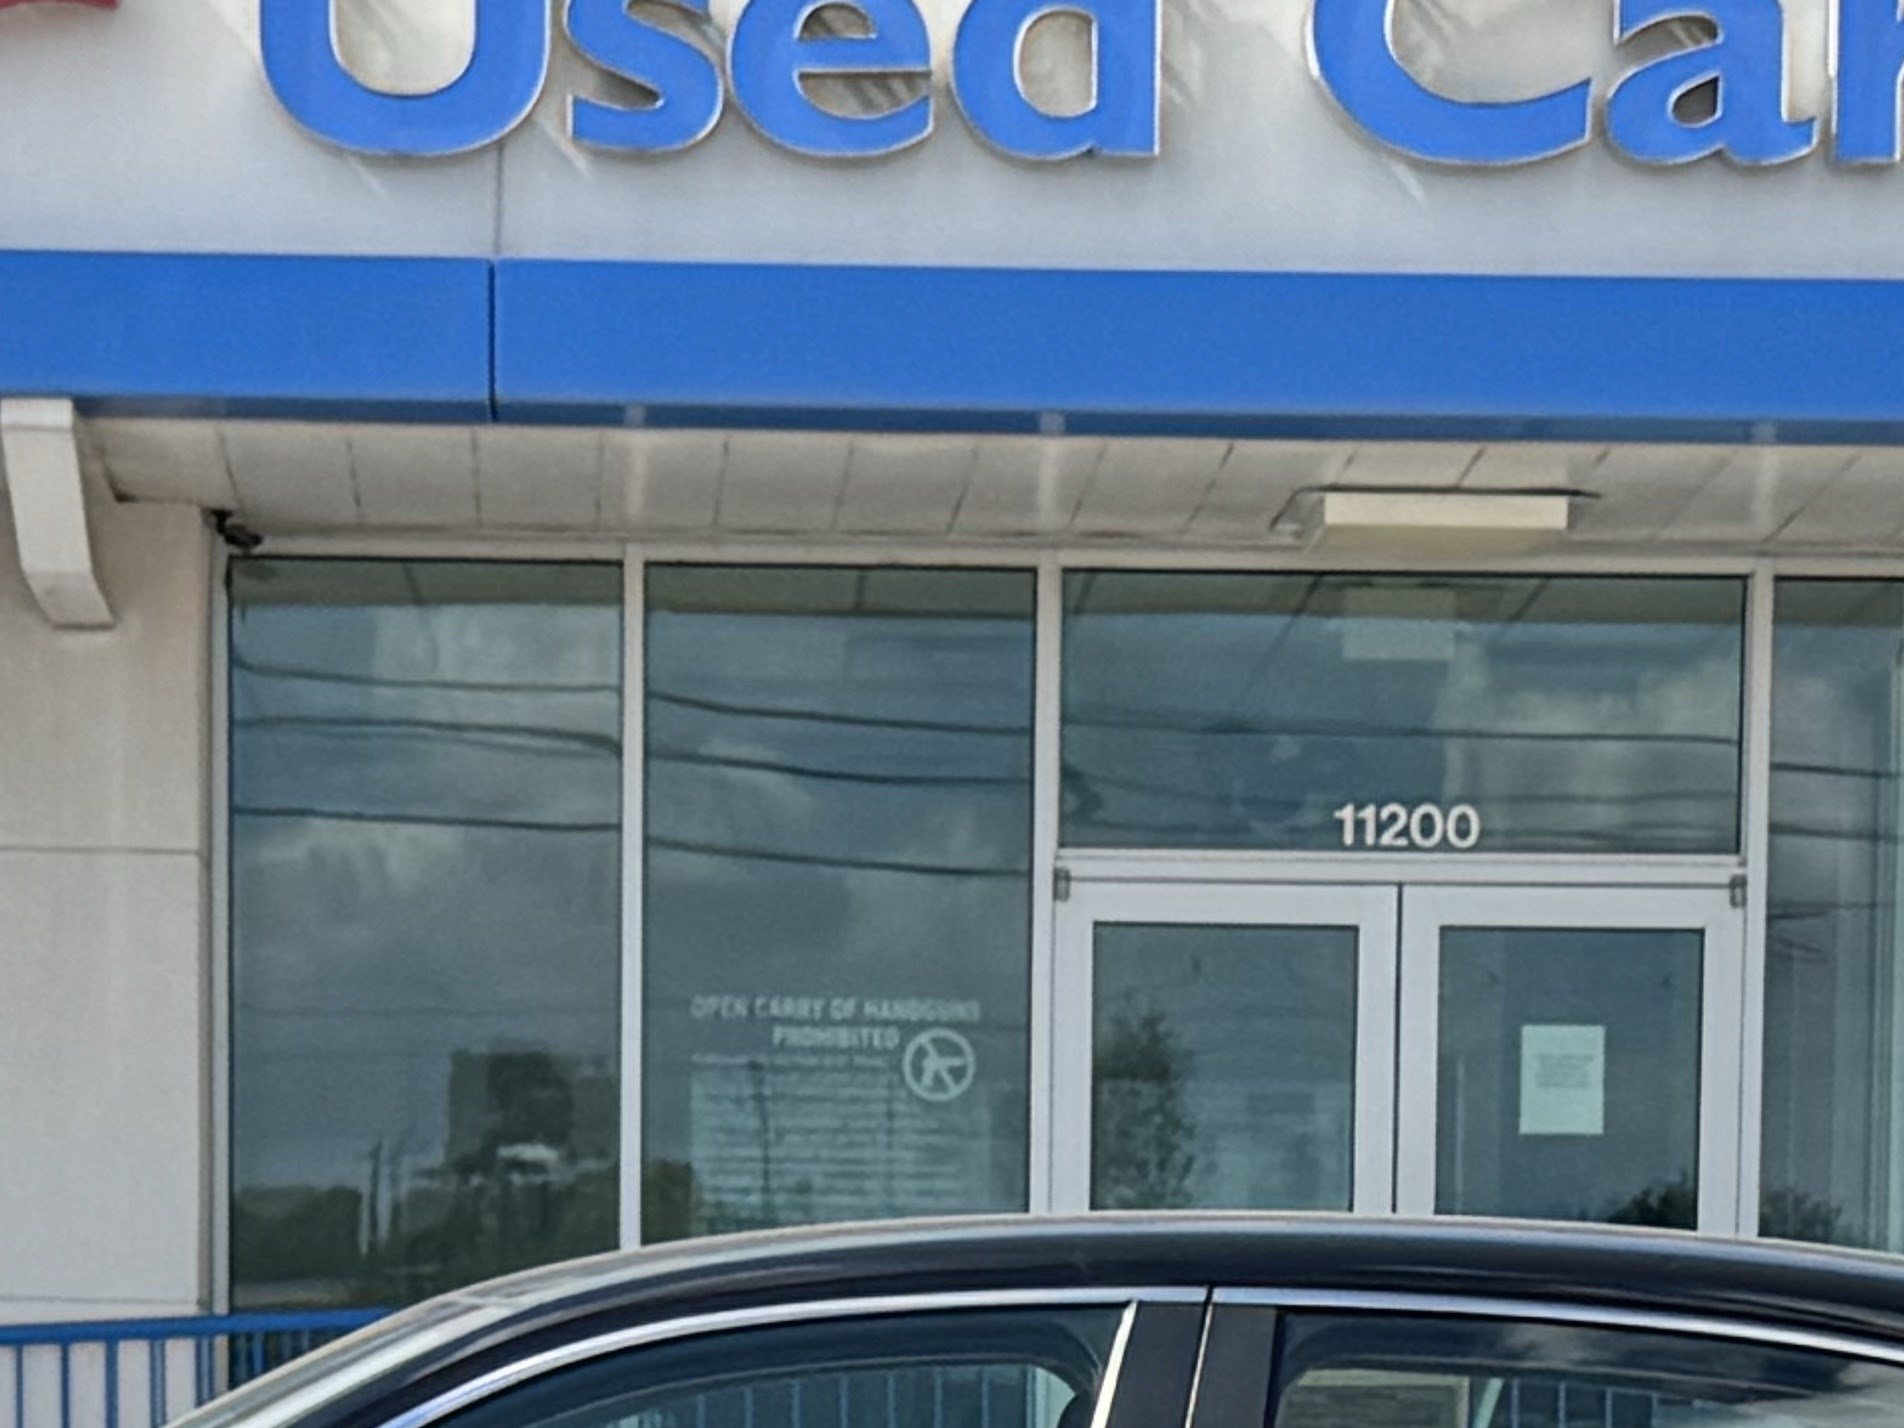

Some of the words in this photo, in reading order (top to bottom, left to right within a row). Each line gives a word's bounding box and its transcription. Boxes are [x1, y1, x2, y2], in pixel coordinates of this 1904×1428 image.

[1333, 802, 1480, 848] 11200
[691, 995, 747, 1019] OPEN
[754, 996, 822, 1020] CARRY
[830, 997, 856, 1020] OF
[772, 1025, 900, 1050] PROHIBITED
